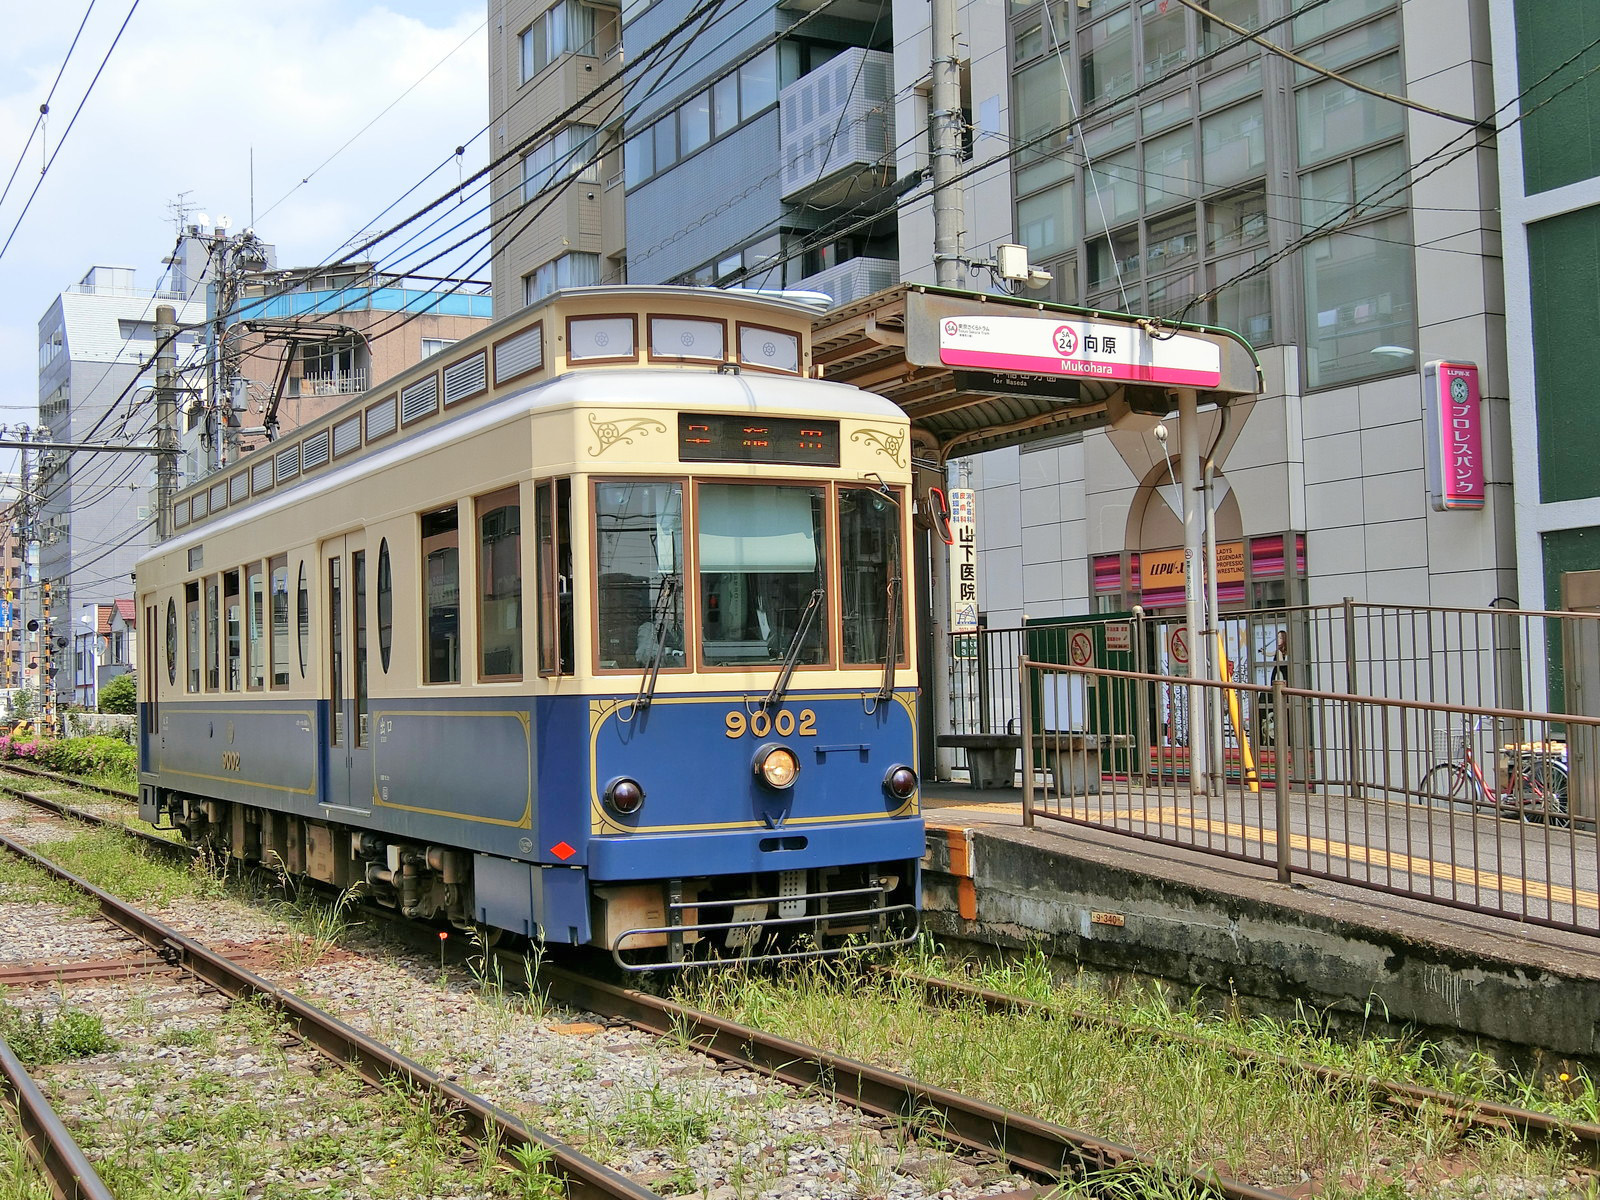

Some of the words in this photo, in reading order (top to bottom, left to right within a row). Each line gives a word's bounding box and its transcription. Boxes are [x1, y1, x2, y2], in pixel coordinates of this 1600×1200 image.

[1059, 338, 1072, 349] 24
[1084, 334, 1117, 354] 向原
[1061, 360, 1113, 374] Mukohara
[1006, 378, 1028, 387] Waseda
[1452, 405, 1474, 493] プロレスバンク
[959, 525, 976, 601] 山下医院
[725, 709, 817, 738] 9002
[222, 751, 240, 771] 9002
